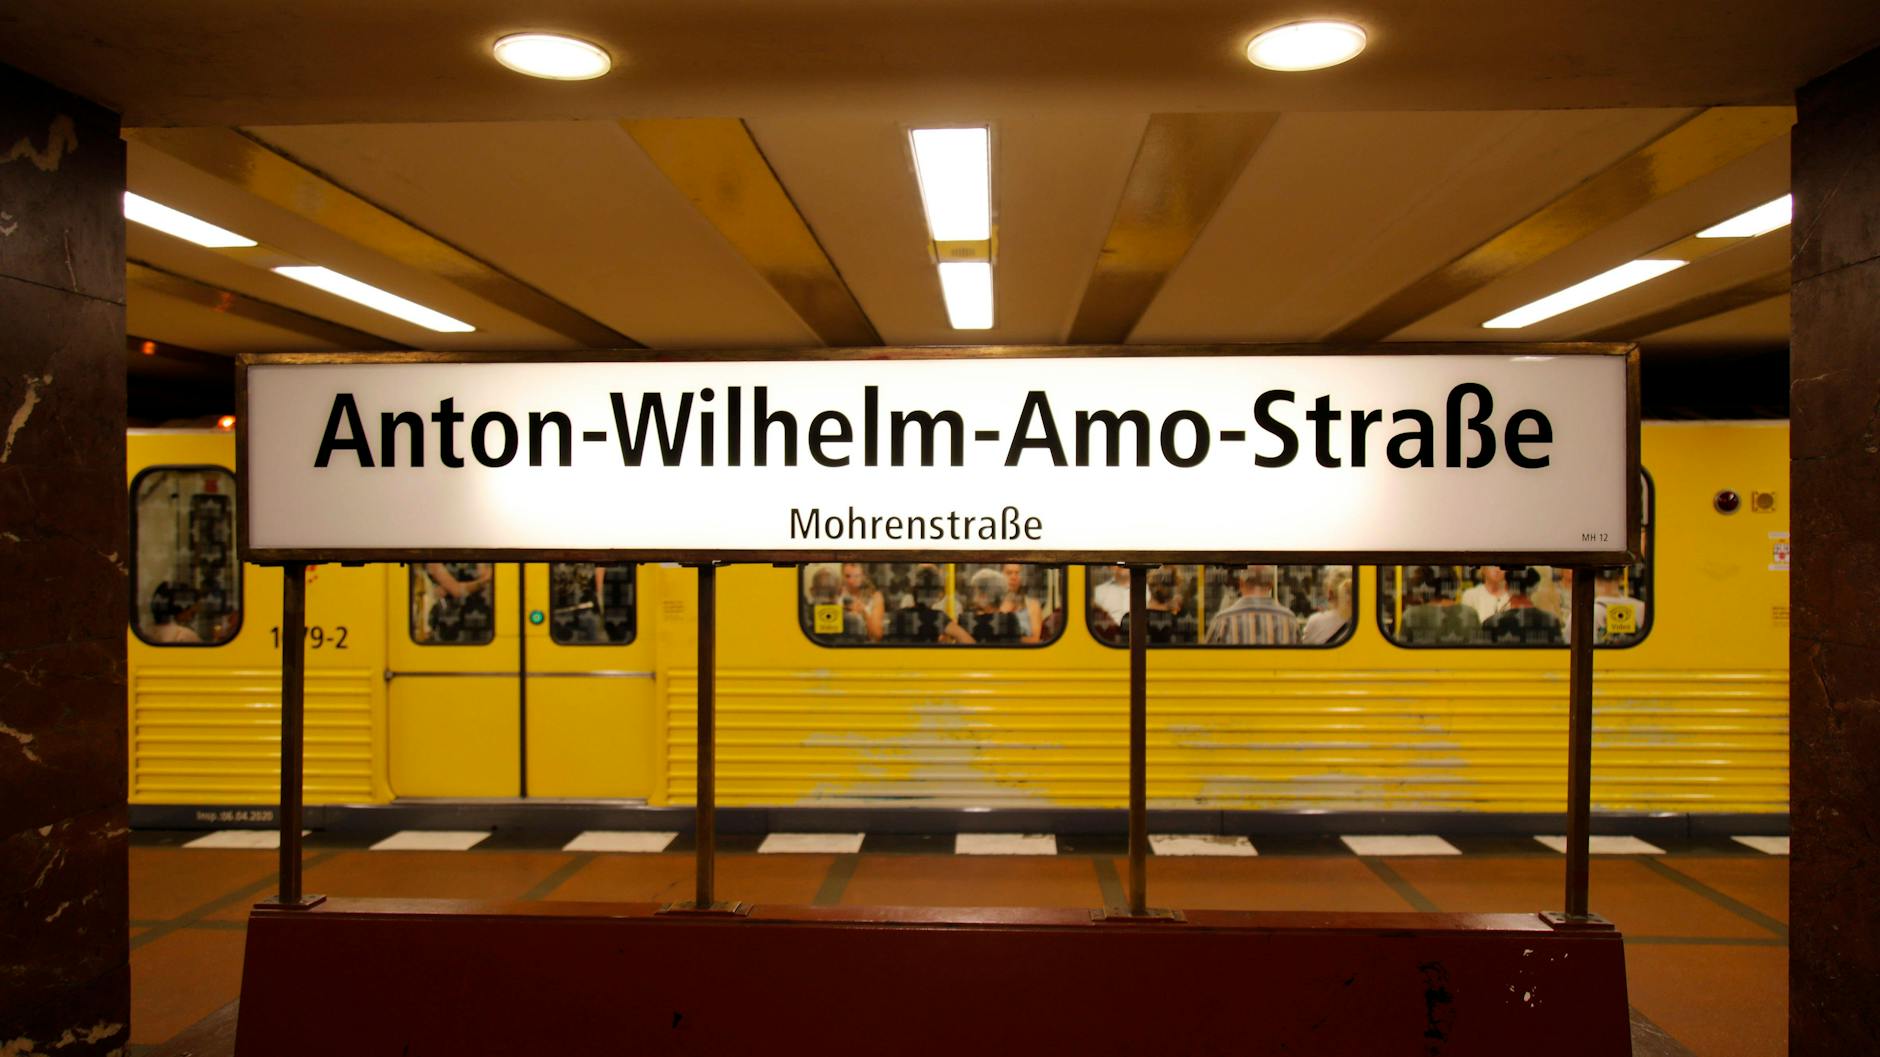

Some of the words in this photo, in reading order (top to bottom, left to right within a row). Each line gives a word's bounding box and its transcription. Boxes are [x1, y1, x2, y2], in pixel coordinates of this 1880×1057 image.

[314, 382, 1553, 469] Anton-Wilhelm-Amo-Straße
[790, 506, 1043, 541] Mohrenstraße
[1581, 533, 1596, 542] MH
[1599, 533, 1609, 542] 12
